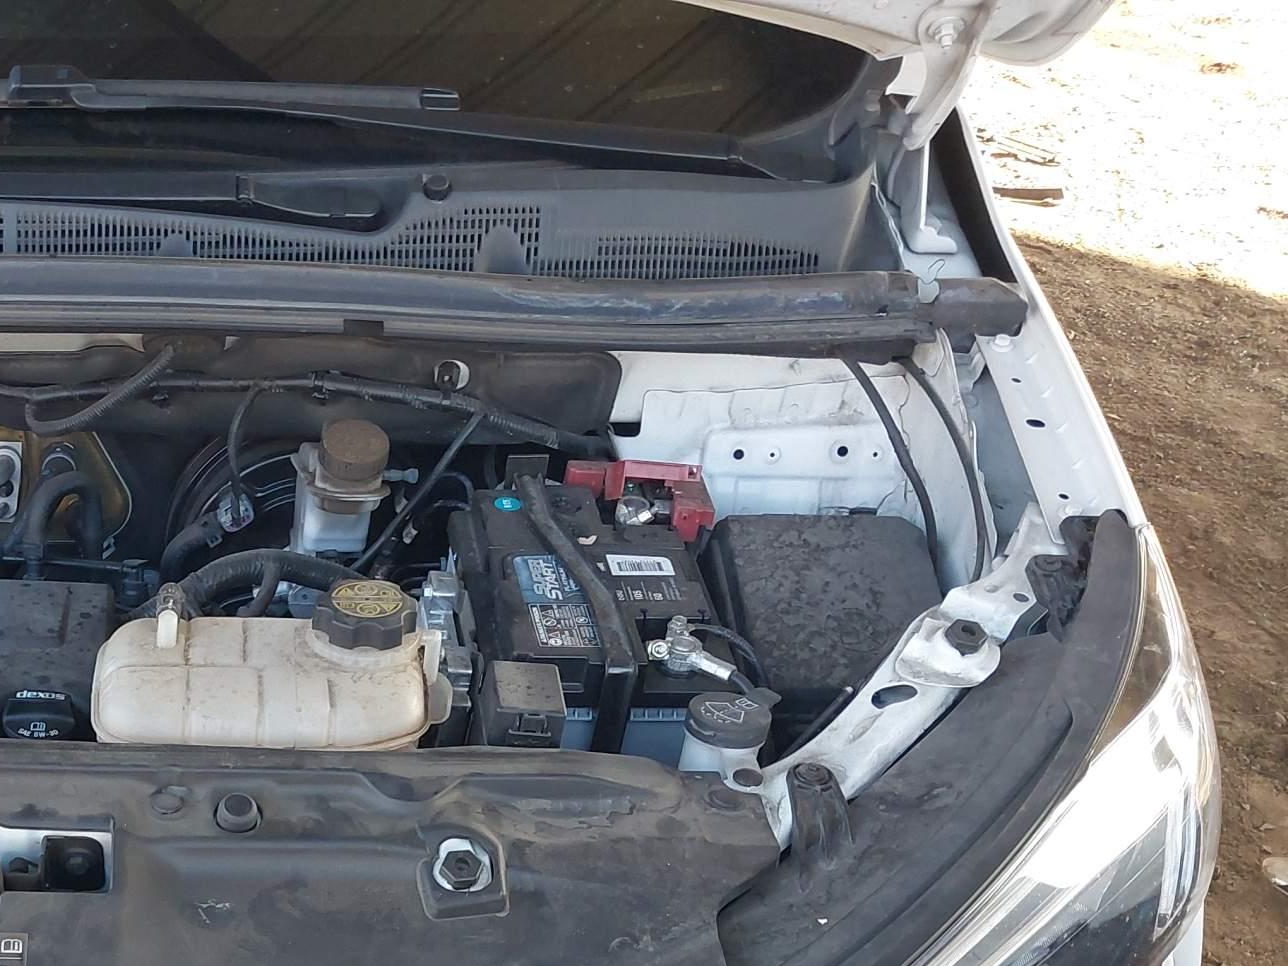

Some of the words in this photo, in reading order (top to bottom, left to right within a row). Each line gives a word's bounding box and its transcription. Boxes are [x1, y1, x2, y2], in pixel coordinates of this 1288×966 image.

[528, 559, 544, 595] SUPER
[542, 559, 564, 600] START
[16, 690, 65, 700] dexos
[18, 728, 32, 737] SAE
